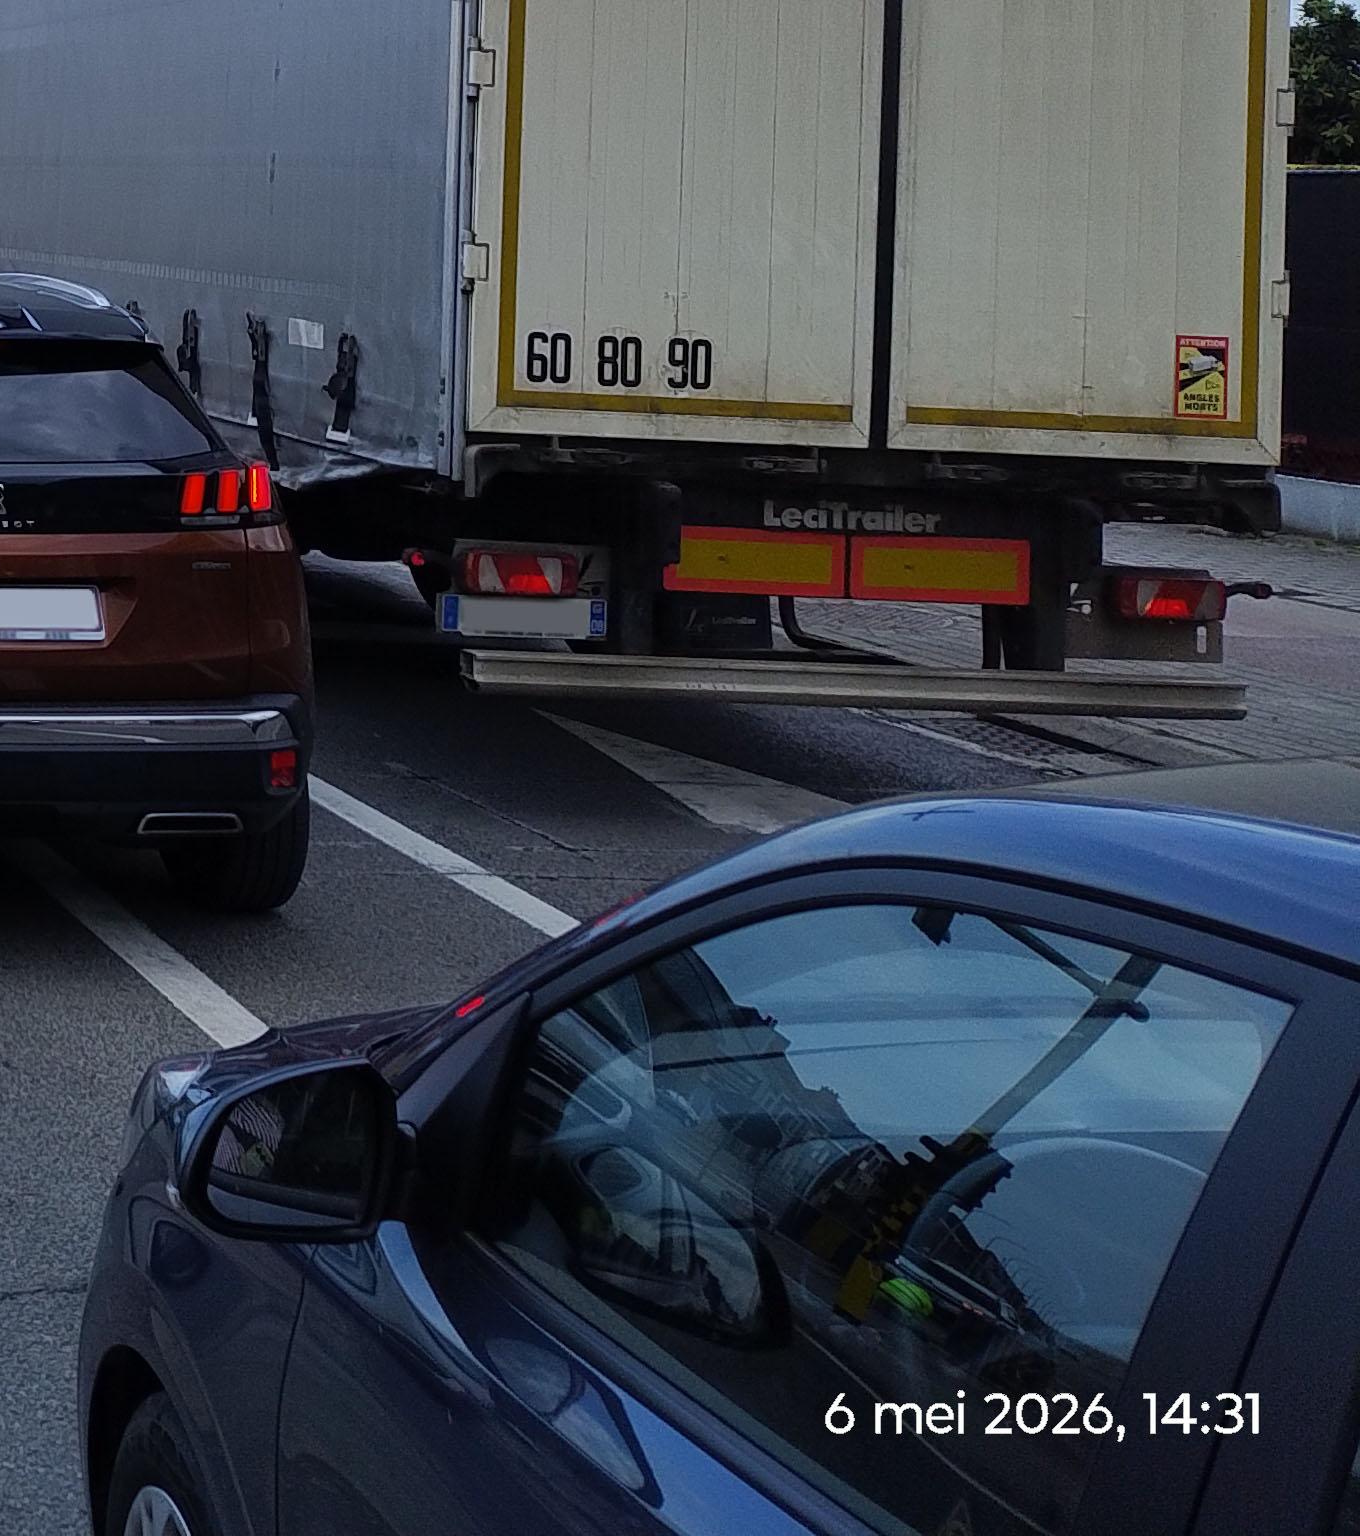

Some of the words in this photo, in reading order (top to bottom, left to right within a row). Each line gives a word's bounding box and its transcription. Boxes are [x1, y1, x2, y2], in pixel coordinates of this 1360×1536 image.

[526, 331, 572, 384] 60
[597, 335, 643, 388] 80
[667, 337, 713, 390] 90
[763, 498, 942, 534] LeciTrailer
